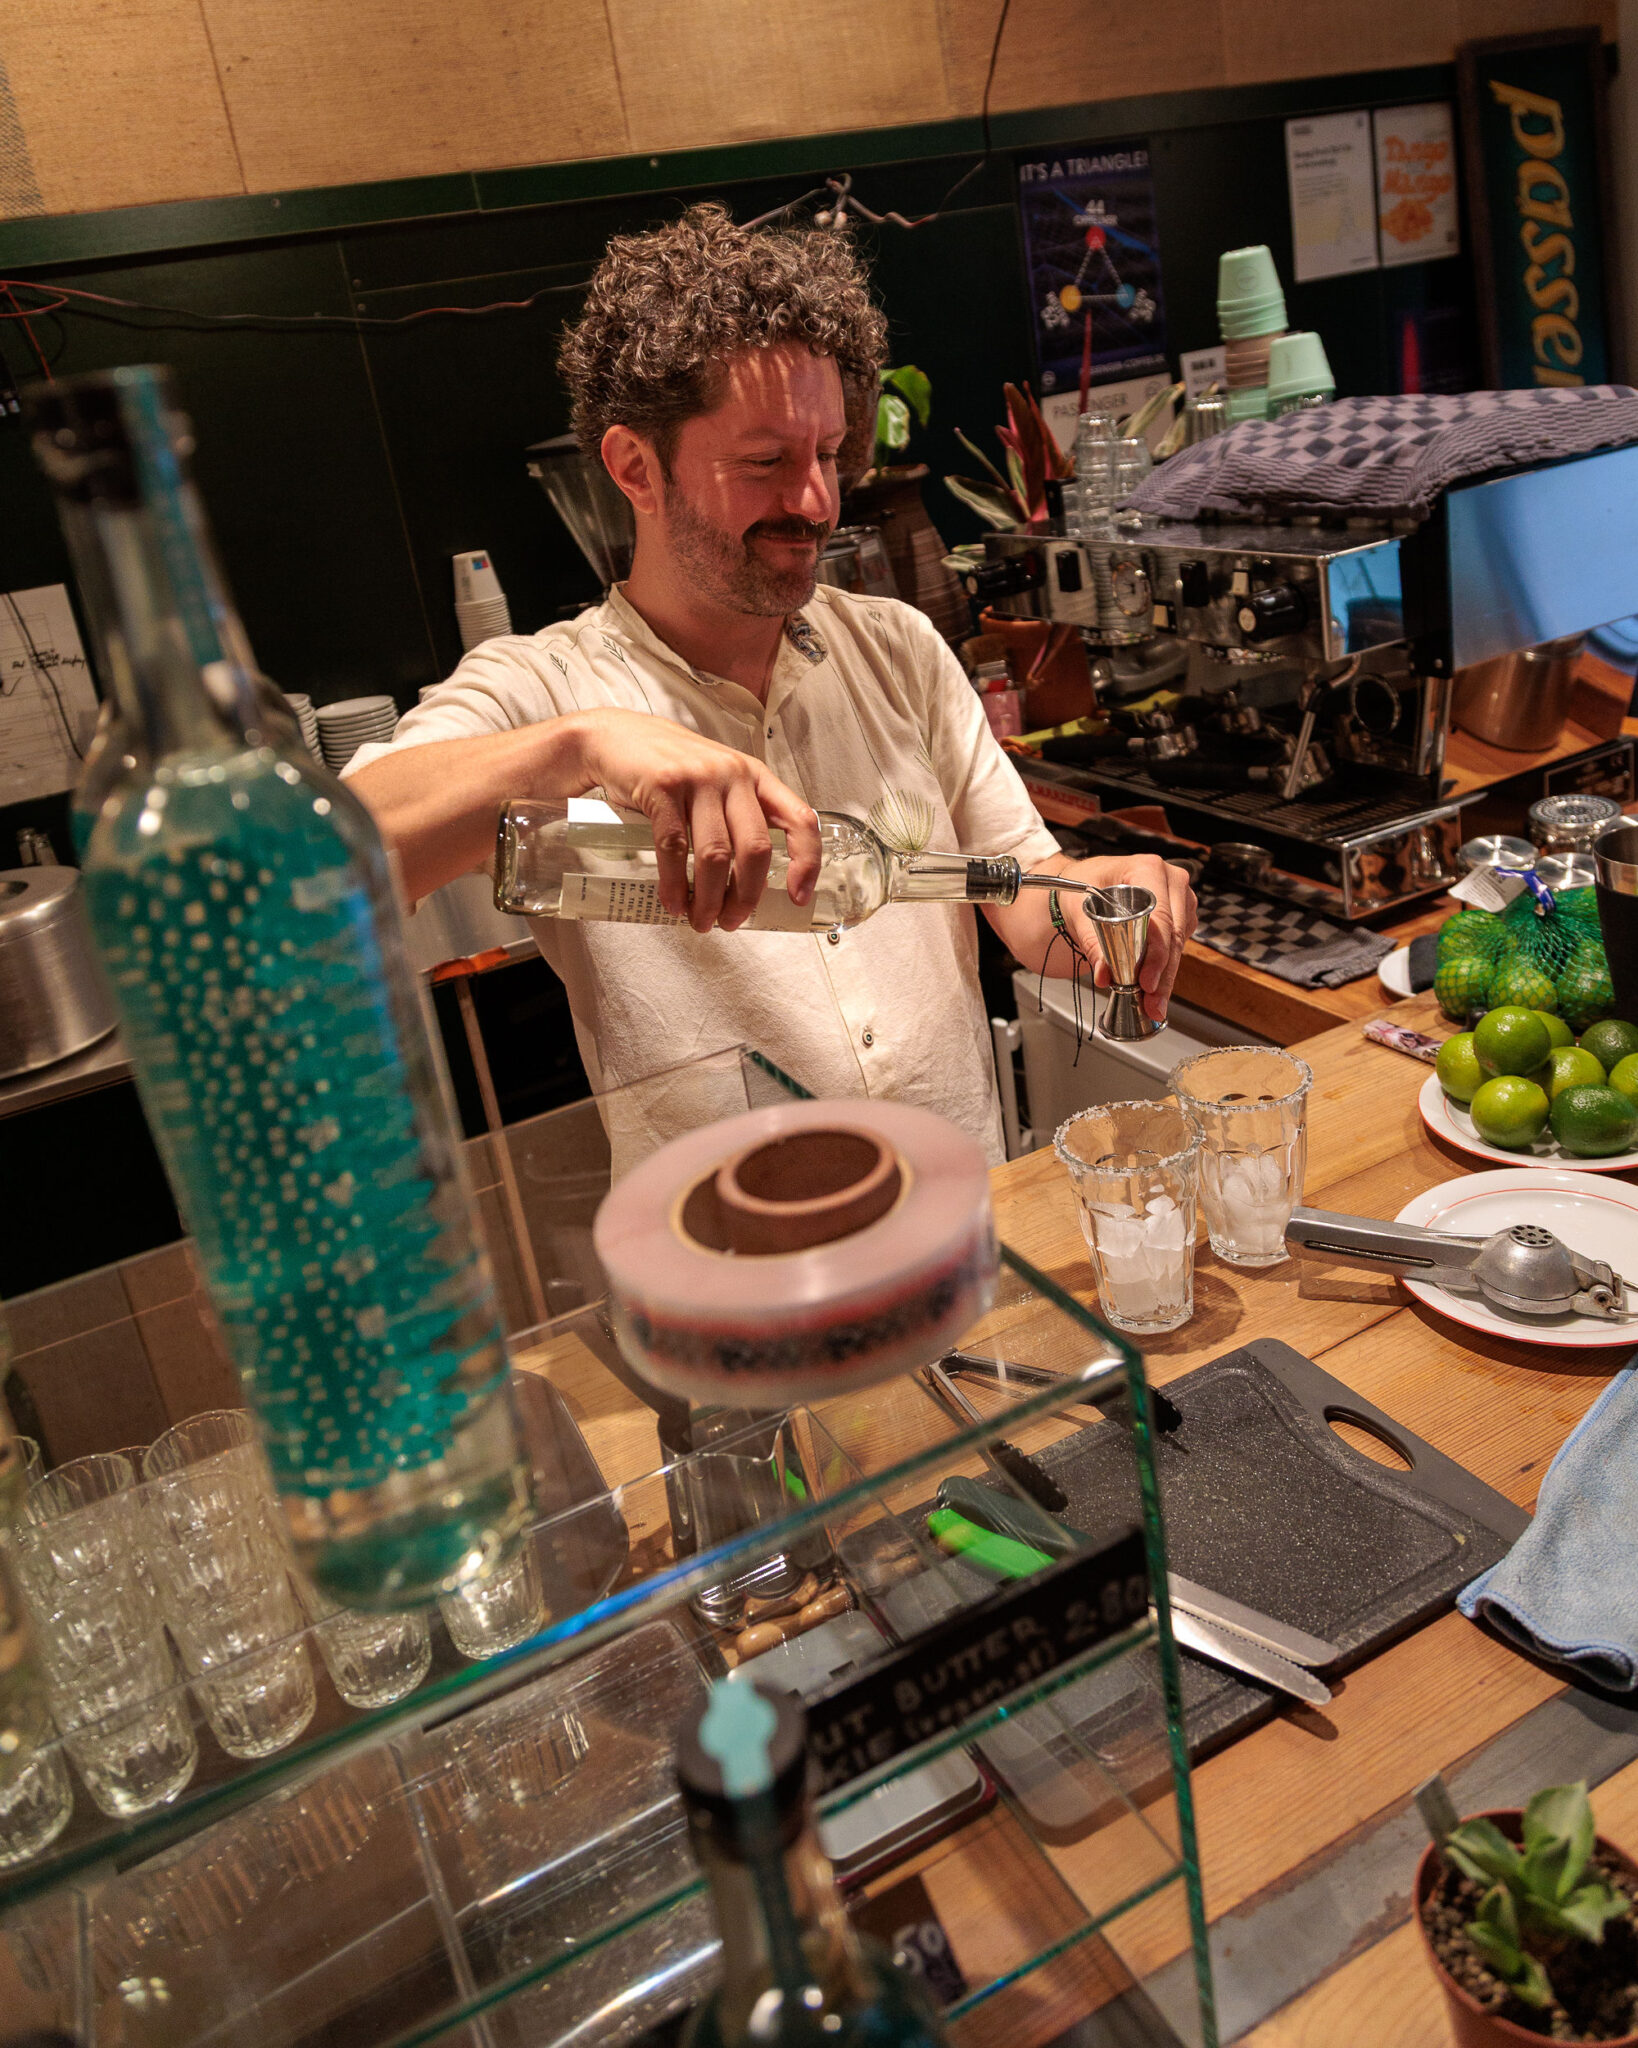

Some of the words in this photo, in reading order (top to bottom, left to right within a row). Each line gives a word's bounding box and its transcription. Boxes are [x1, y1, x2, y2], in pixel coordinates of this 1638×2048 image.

[1020, 161, 1049, 183] IT'S
[1050, 161, 1065, 179] A
[1067, 150, 1150, 177] TRIANGLE!
[1053, 392, 1129, 418] PASNGER
[631, 883, 636, 891] EL
[640, 883, 646, 893] OF
[647, 884, 655, 899] THE
[893, 1616, 1048, 1713] BUTTER
